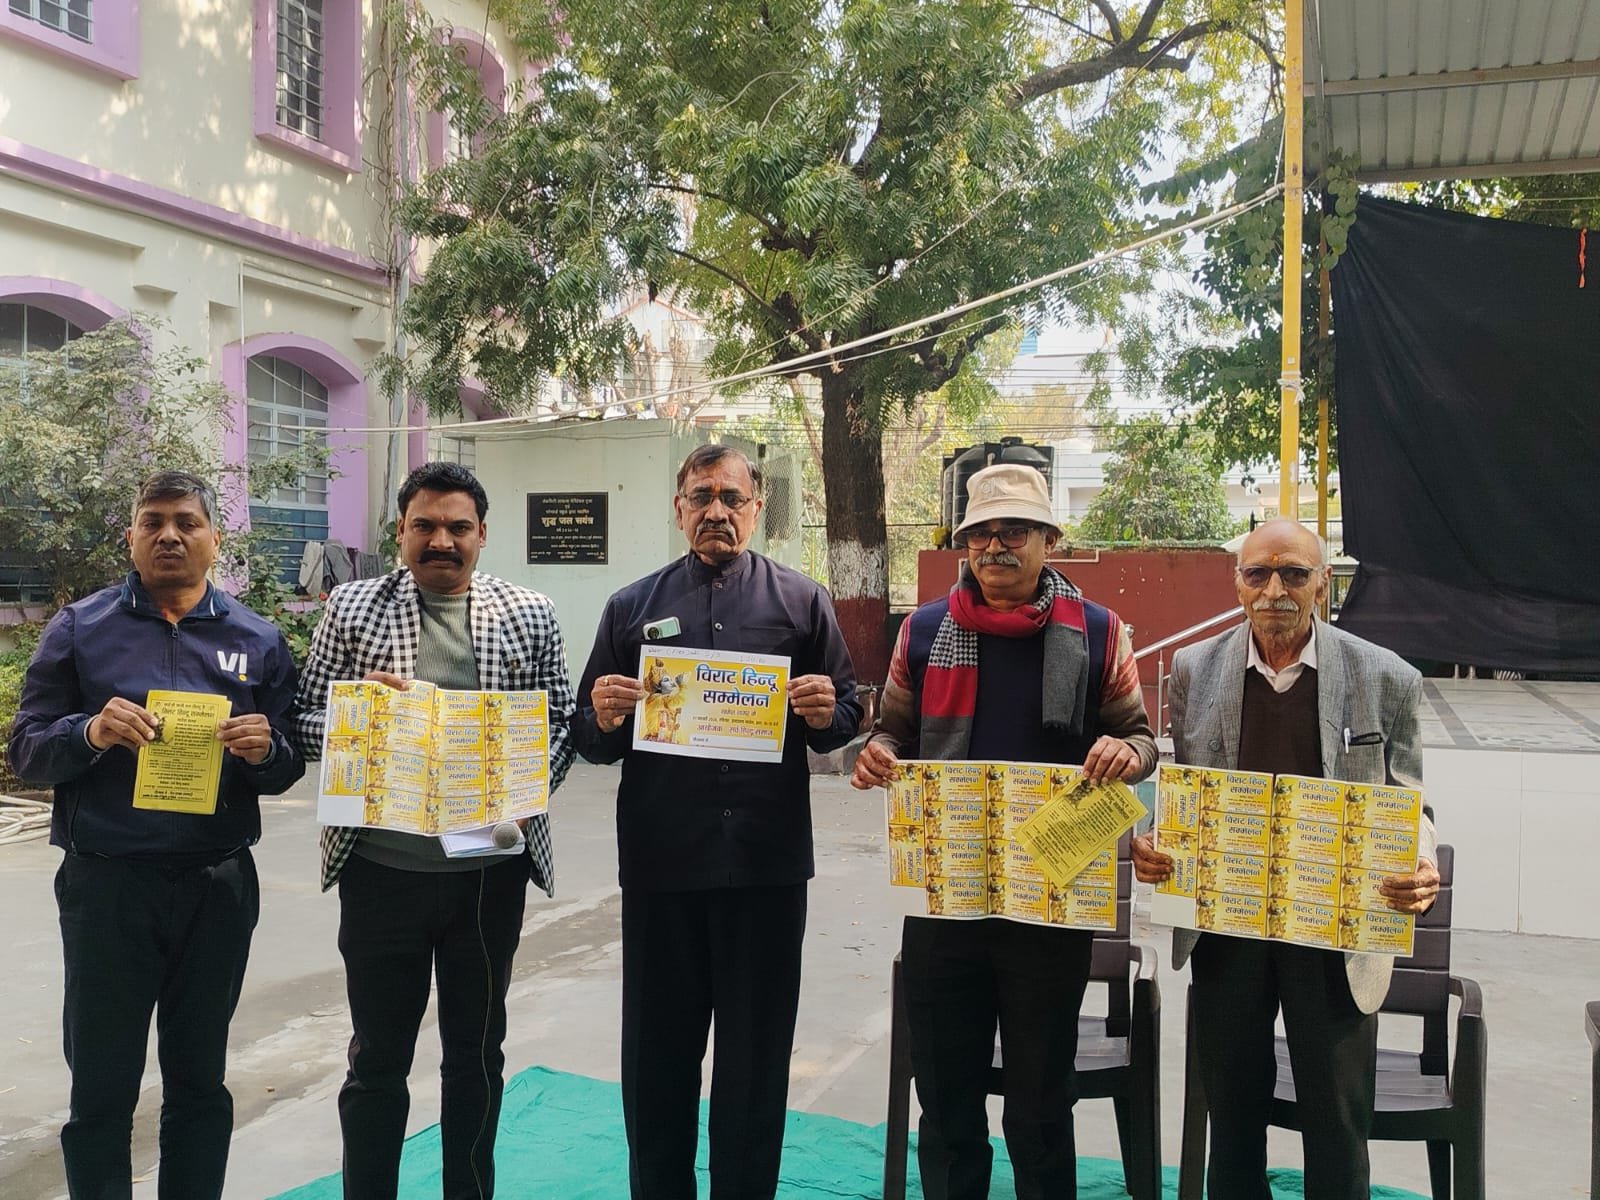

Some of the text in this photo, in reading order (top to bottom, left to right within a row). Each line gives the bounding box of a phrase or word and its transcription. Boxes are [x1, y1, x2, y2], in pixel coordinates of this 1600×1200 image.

[541, 517, 557, 527] शुद्ध
[696, 664, 778, 693] विराट हिन्दू
[703, 688, 769, 708] सम्मेलन
